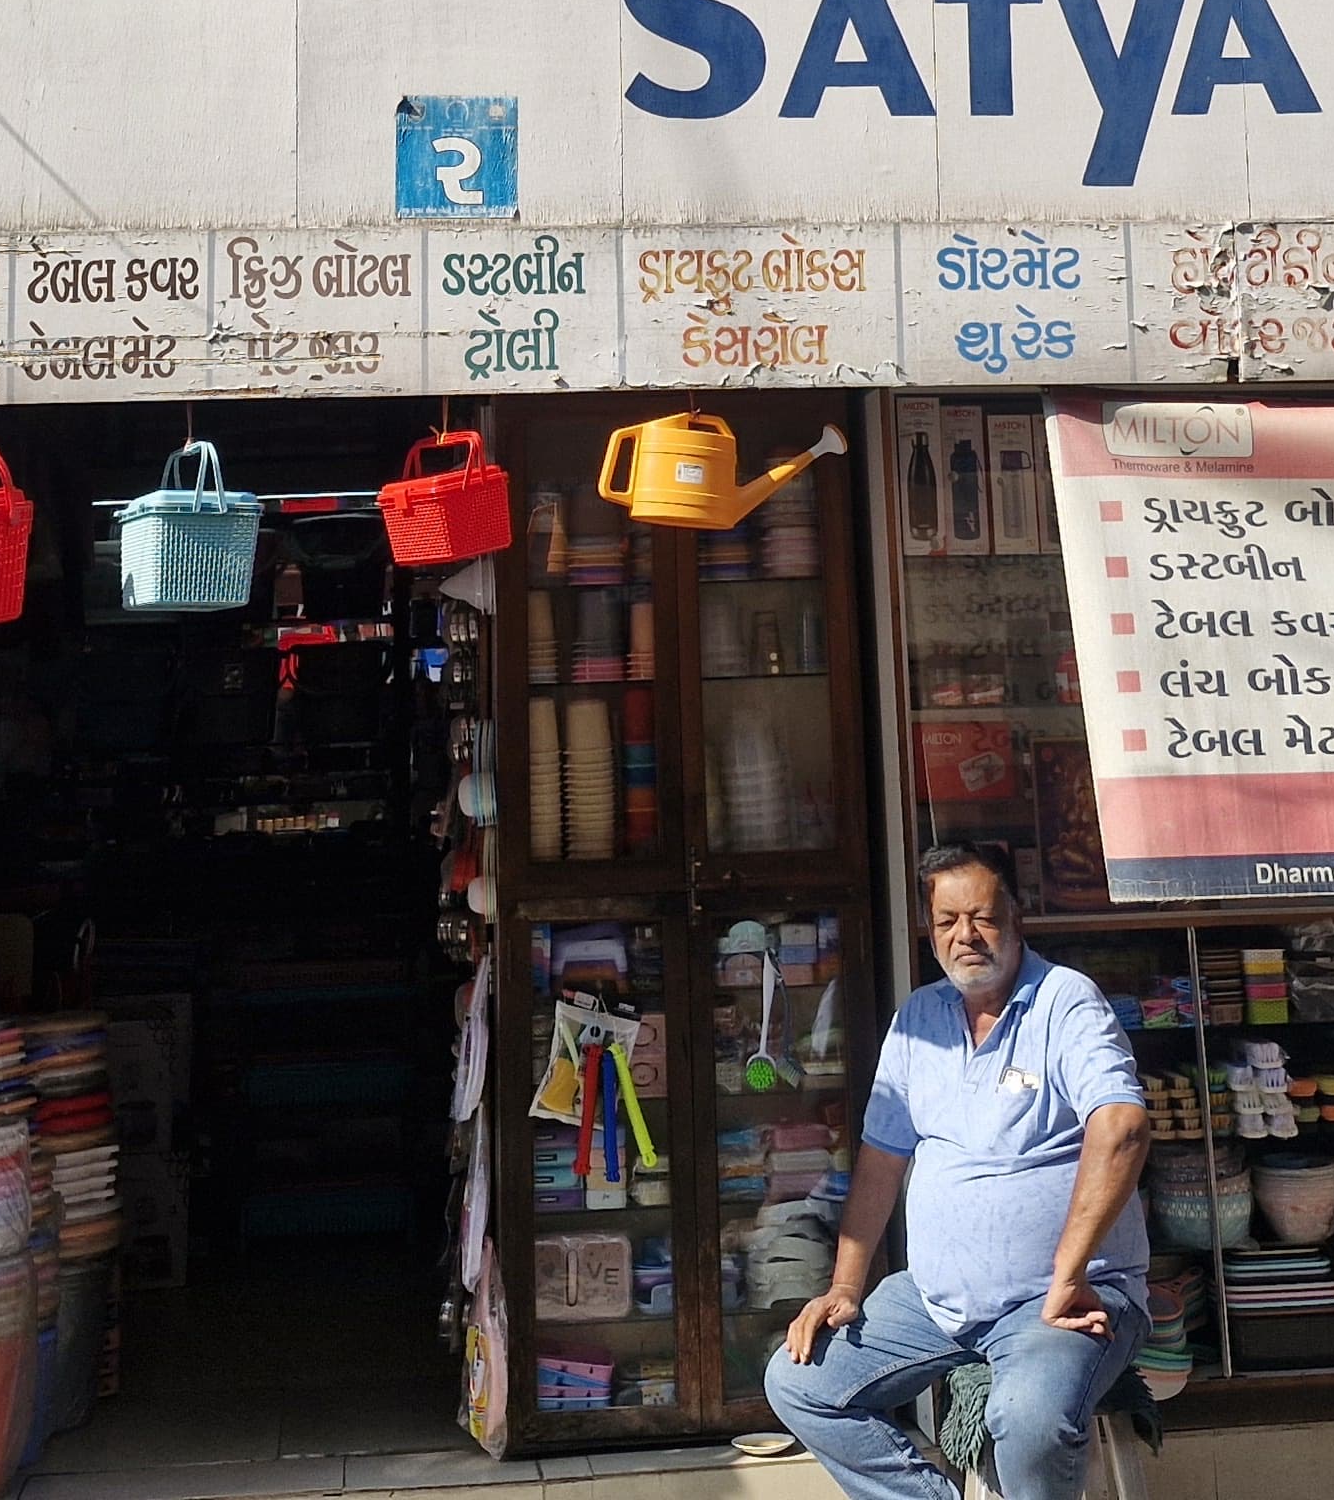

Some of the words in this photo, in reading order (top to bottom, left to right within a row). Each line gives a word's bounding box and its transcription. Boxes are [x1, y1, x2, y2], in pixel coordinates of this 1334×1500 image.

[27, 243, 114, 303] ટેબલ
[125, 258, 199, 301] કવર
[312, 239, 411, 298] બોટલ
[441, 235, 585, 296] ડસ્ટબીન
[937, 230, 1080, 290] ડોરમેટ
[1011, 305, 1075, 359] રેક
[1112, 416, 1240, 445] MILTON
[1112, 458, 1180, 473] Thermoware
[1196, 461, 1254, 473] Melamine
[1149, 550, 1307, 583] ડસ્ટબીન
[1154, 601, 1254, 639] ટેબલ
[1159, 660, 1230, 699] લંચ
[1167, 719, 1265, 758] ટેબલ
